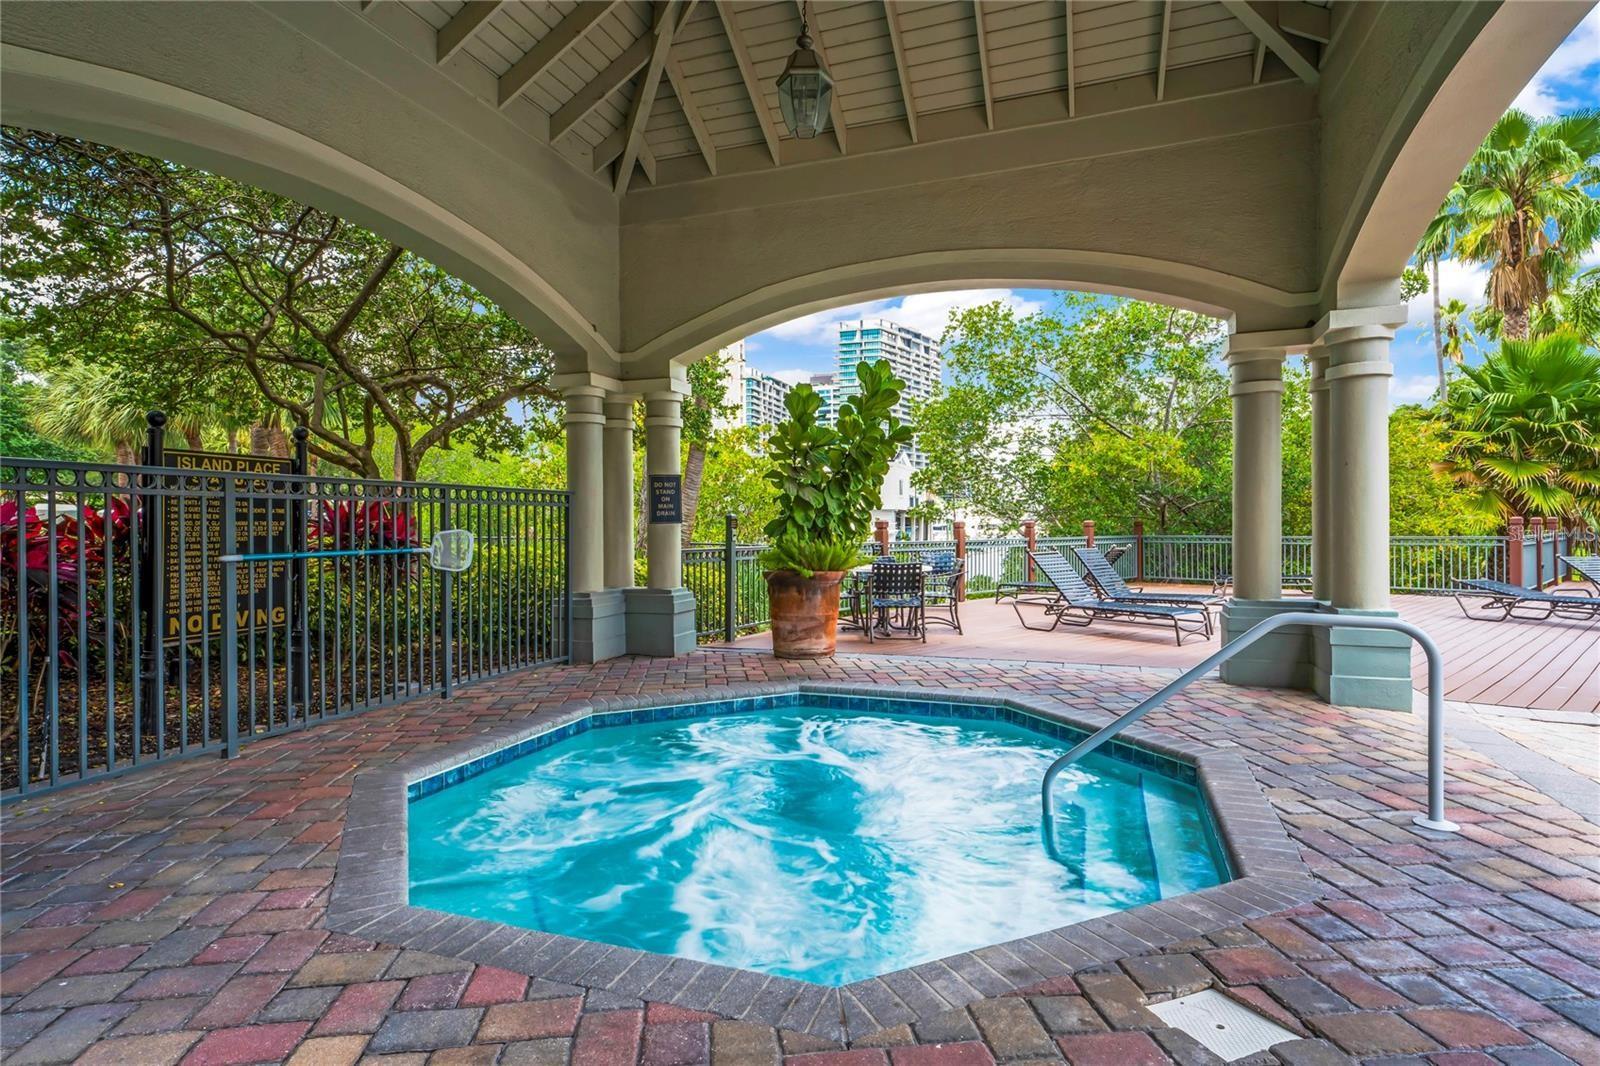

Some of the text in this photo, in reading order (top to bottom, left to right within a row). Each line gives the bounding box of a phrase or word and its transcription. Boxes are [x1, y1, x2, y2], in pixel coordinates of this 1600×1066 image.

[177, 456, 281, 474] ISLAND PLACE
[169, 607, 285, 635] NO DVNG
